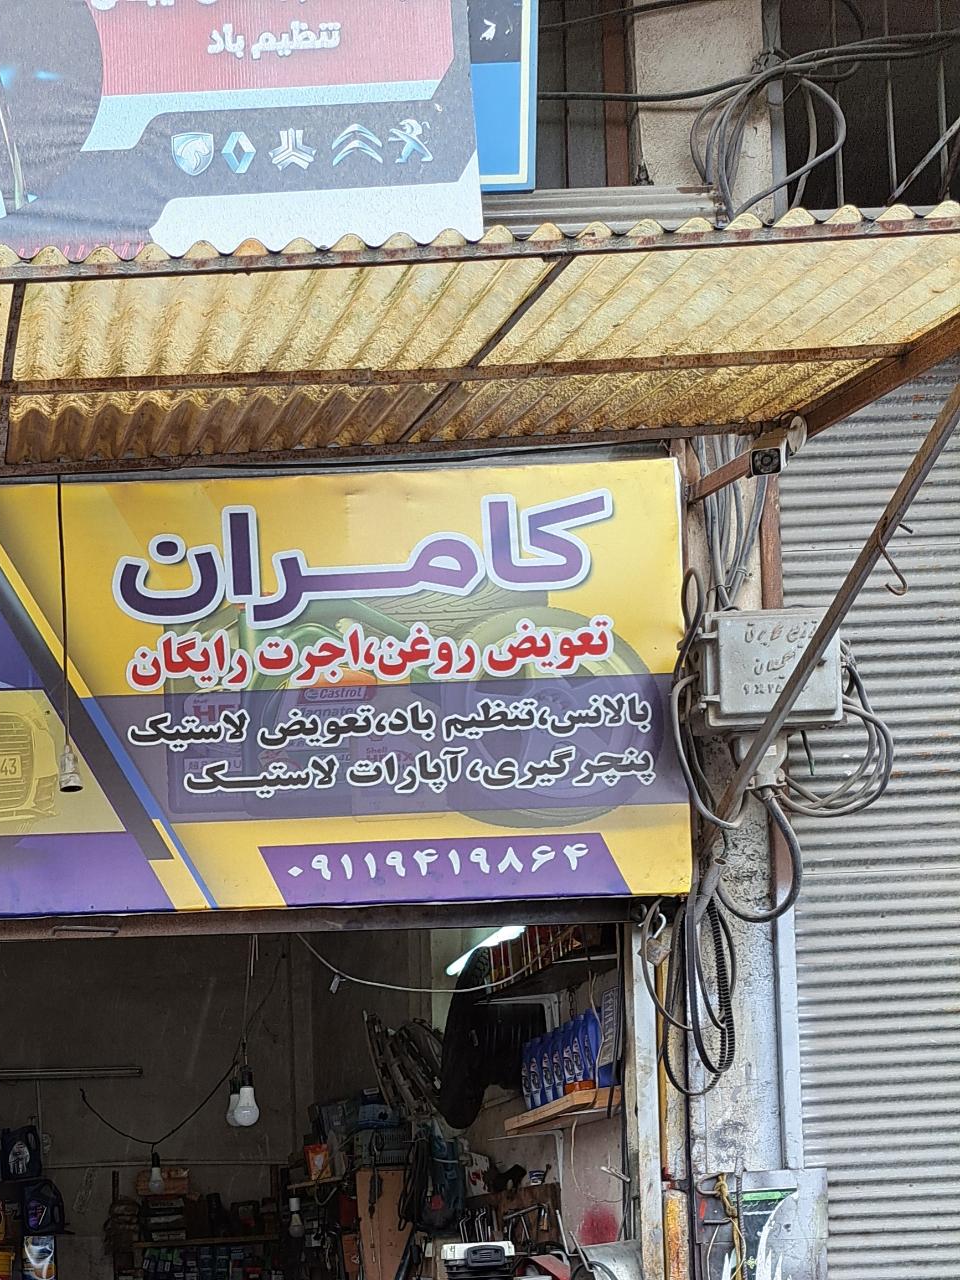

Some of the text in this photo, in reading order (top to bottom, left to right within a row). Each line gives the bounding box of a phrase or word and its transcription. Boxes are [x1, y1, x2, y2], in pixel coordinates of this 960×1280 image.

[207, 21, 340, 59] تنظیم باد
[114, 491, 611, 627] کامران
[129, 629, 247, 687] رایگان
[486, 616, 612, 674] تعویض
[319, 687, 362, 699] Castrol
[127, 709, 250, 751] لاستیک
[184, 754, 339, 797] لاستیک
[288, 843, 589, 881] ۰۹۱۱۹۴۱۹۸۶۴
